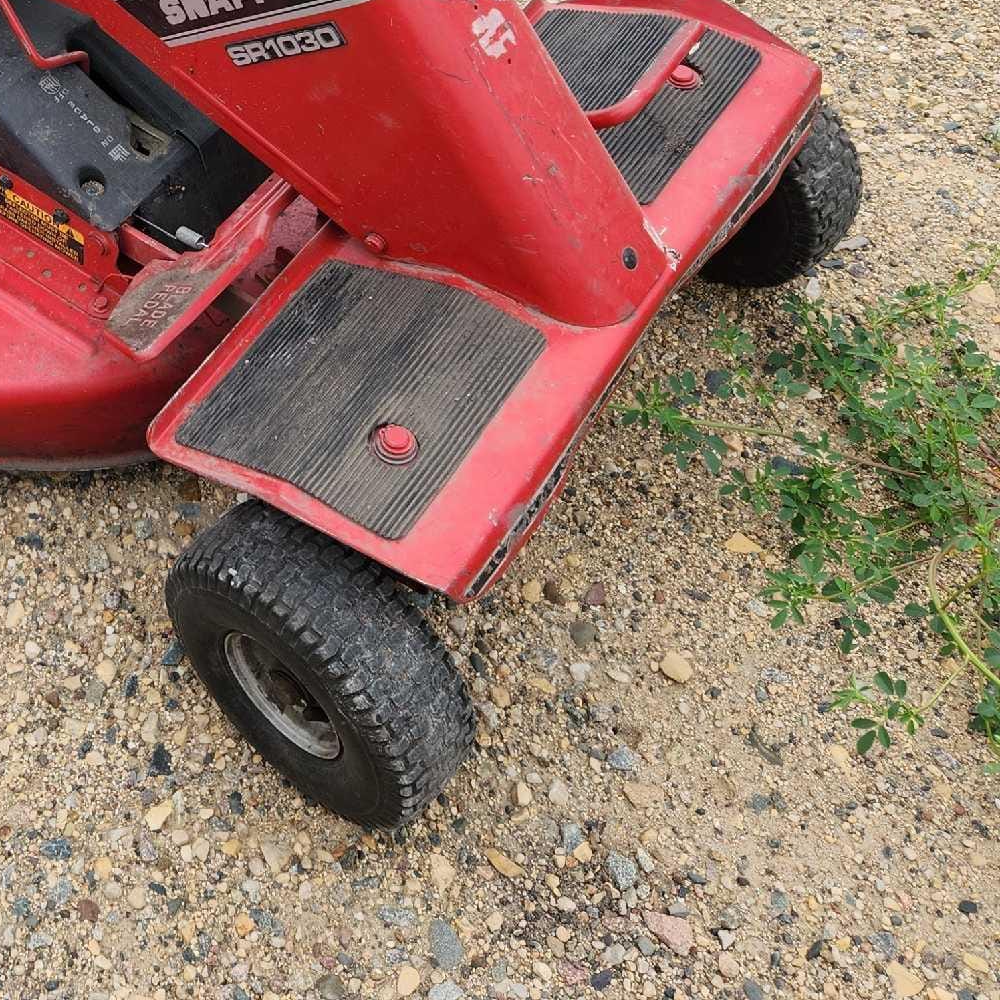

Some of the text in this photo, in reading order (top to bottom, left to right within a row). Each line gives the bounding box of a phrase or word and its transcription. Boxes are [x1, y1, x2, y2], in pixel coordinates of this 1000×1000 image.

[227, 26, 343, 67] SR1030
[120, 283, 177, 328] PEDAL
[141, 286, 193, 328] BLADE
